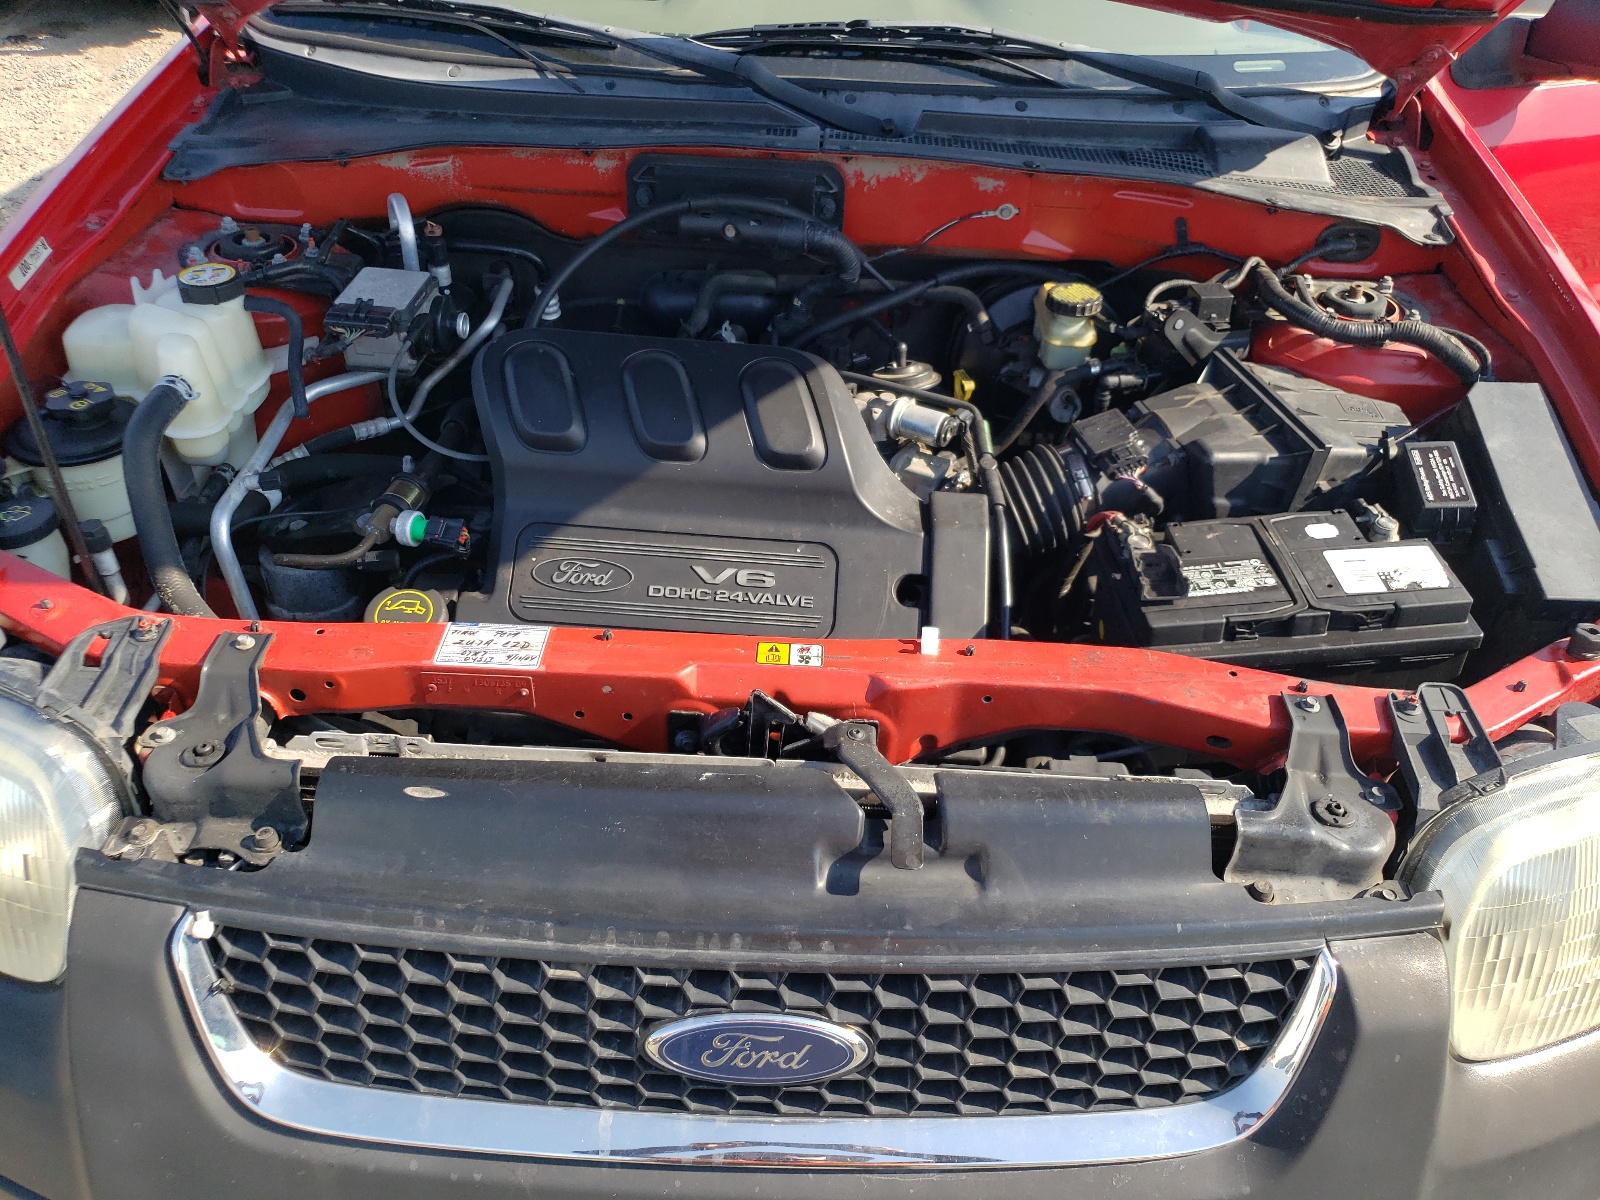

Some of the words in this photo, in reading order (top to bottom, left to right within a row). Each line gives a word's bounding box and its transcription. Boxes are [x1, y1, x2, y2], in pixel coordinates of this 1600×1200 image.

[551, 559, 614, 588] Ford
[690, 565, 776, 588] V6
[648, 585, 712, 601] DOHC
[713, 589, 814, 609] 24-VALVE
[700, 1031, 812, 1070] Ford
